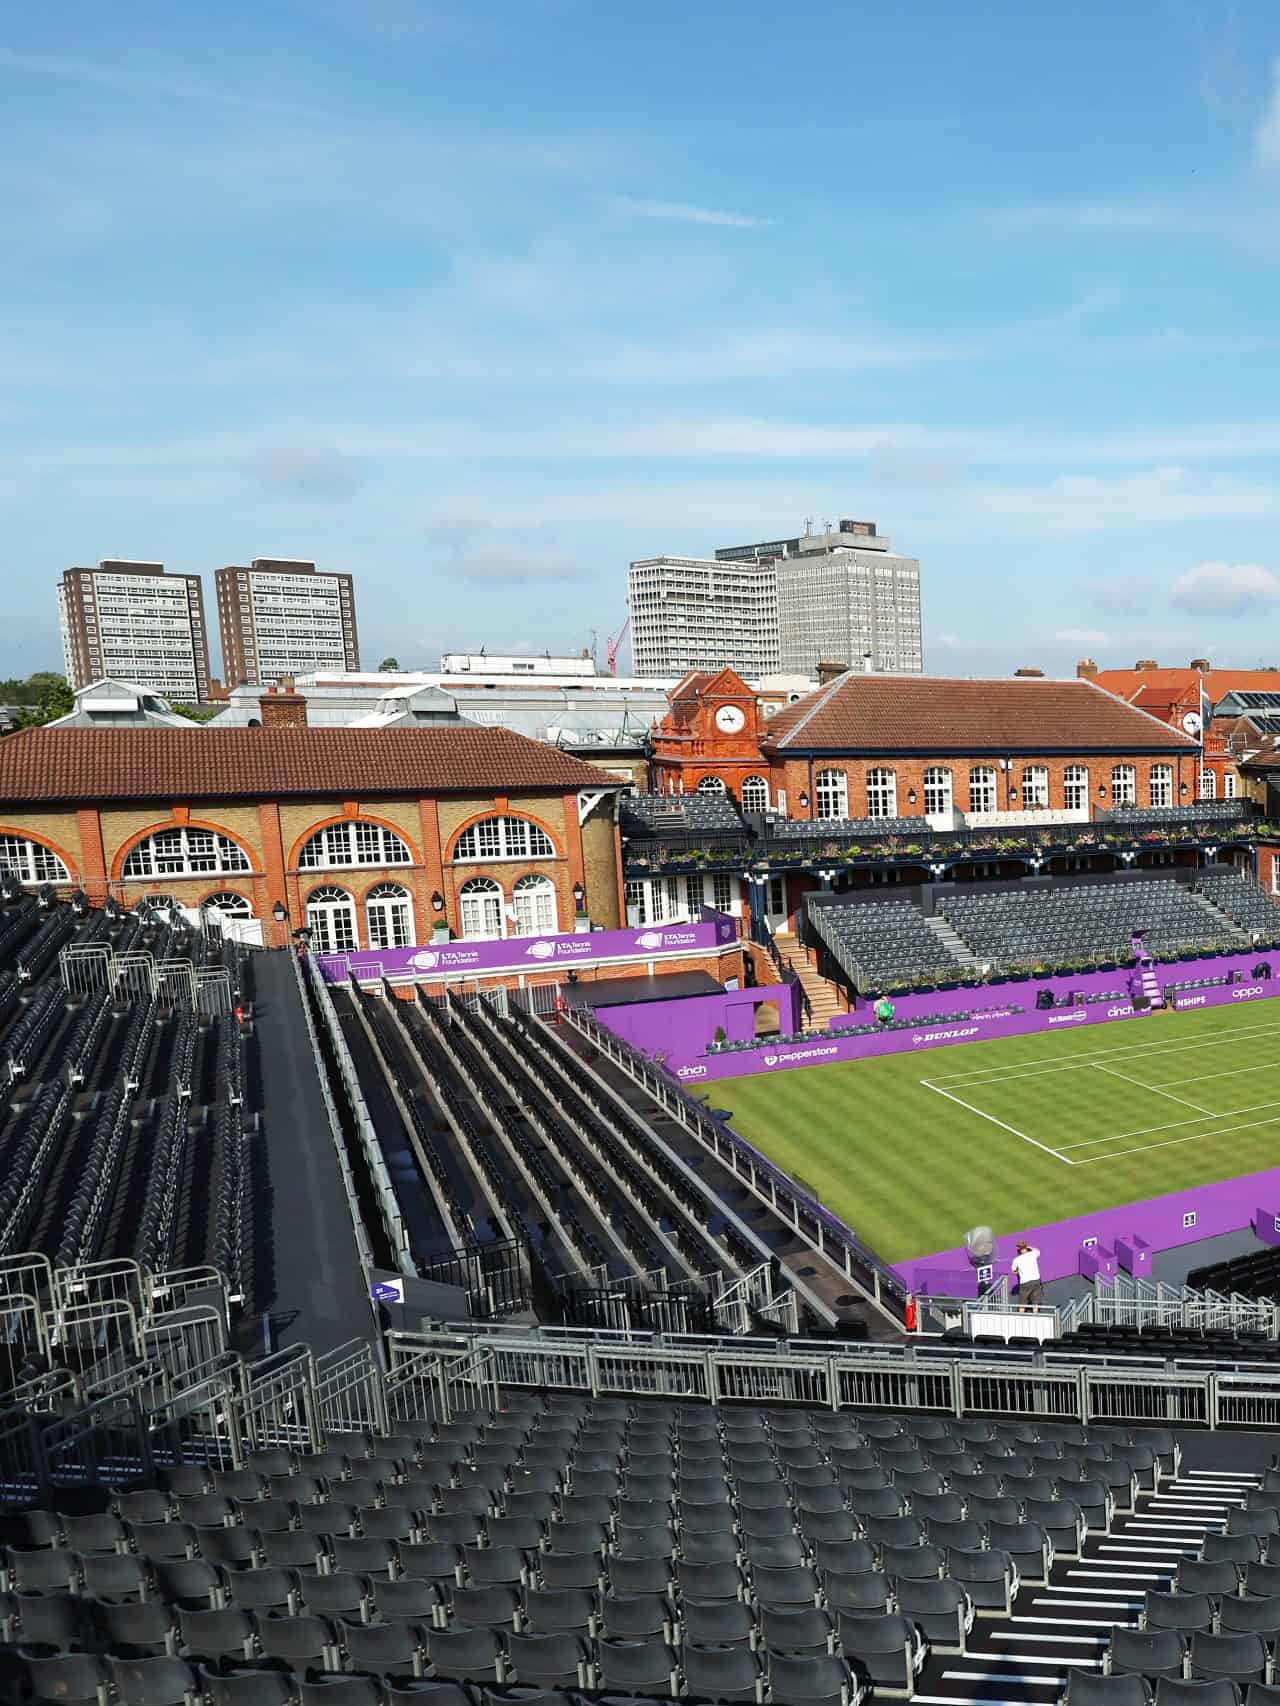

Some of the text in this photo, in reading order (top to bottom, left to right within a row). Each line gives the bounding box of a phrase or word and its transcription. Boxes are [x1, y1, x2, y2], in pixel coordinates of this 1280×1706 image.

[1232, 986, 1263, 998] oppo
[1107, 1002, 1134, 1017] cinch
[924, 1027, 979, 1041] DUNLOP
[778, 1046, 839, 1063] pepperstone
[677, 1064, 707, 1077] cinch
